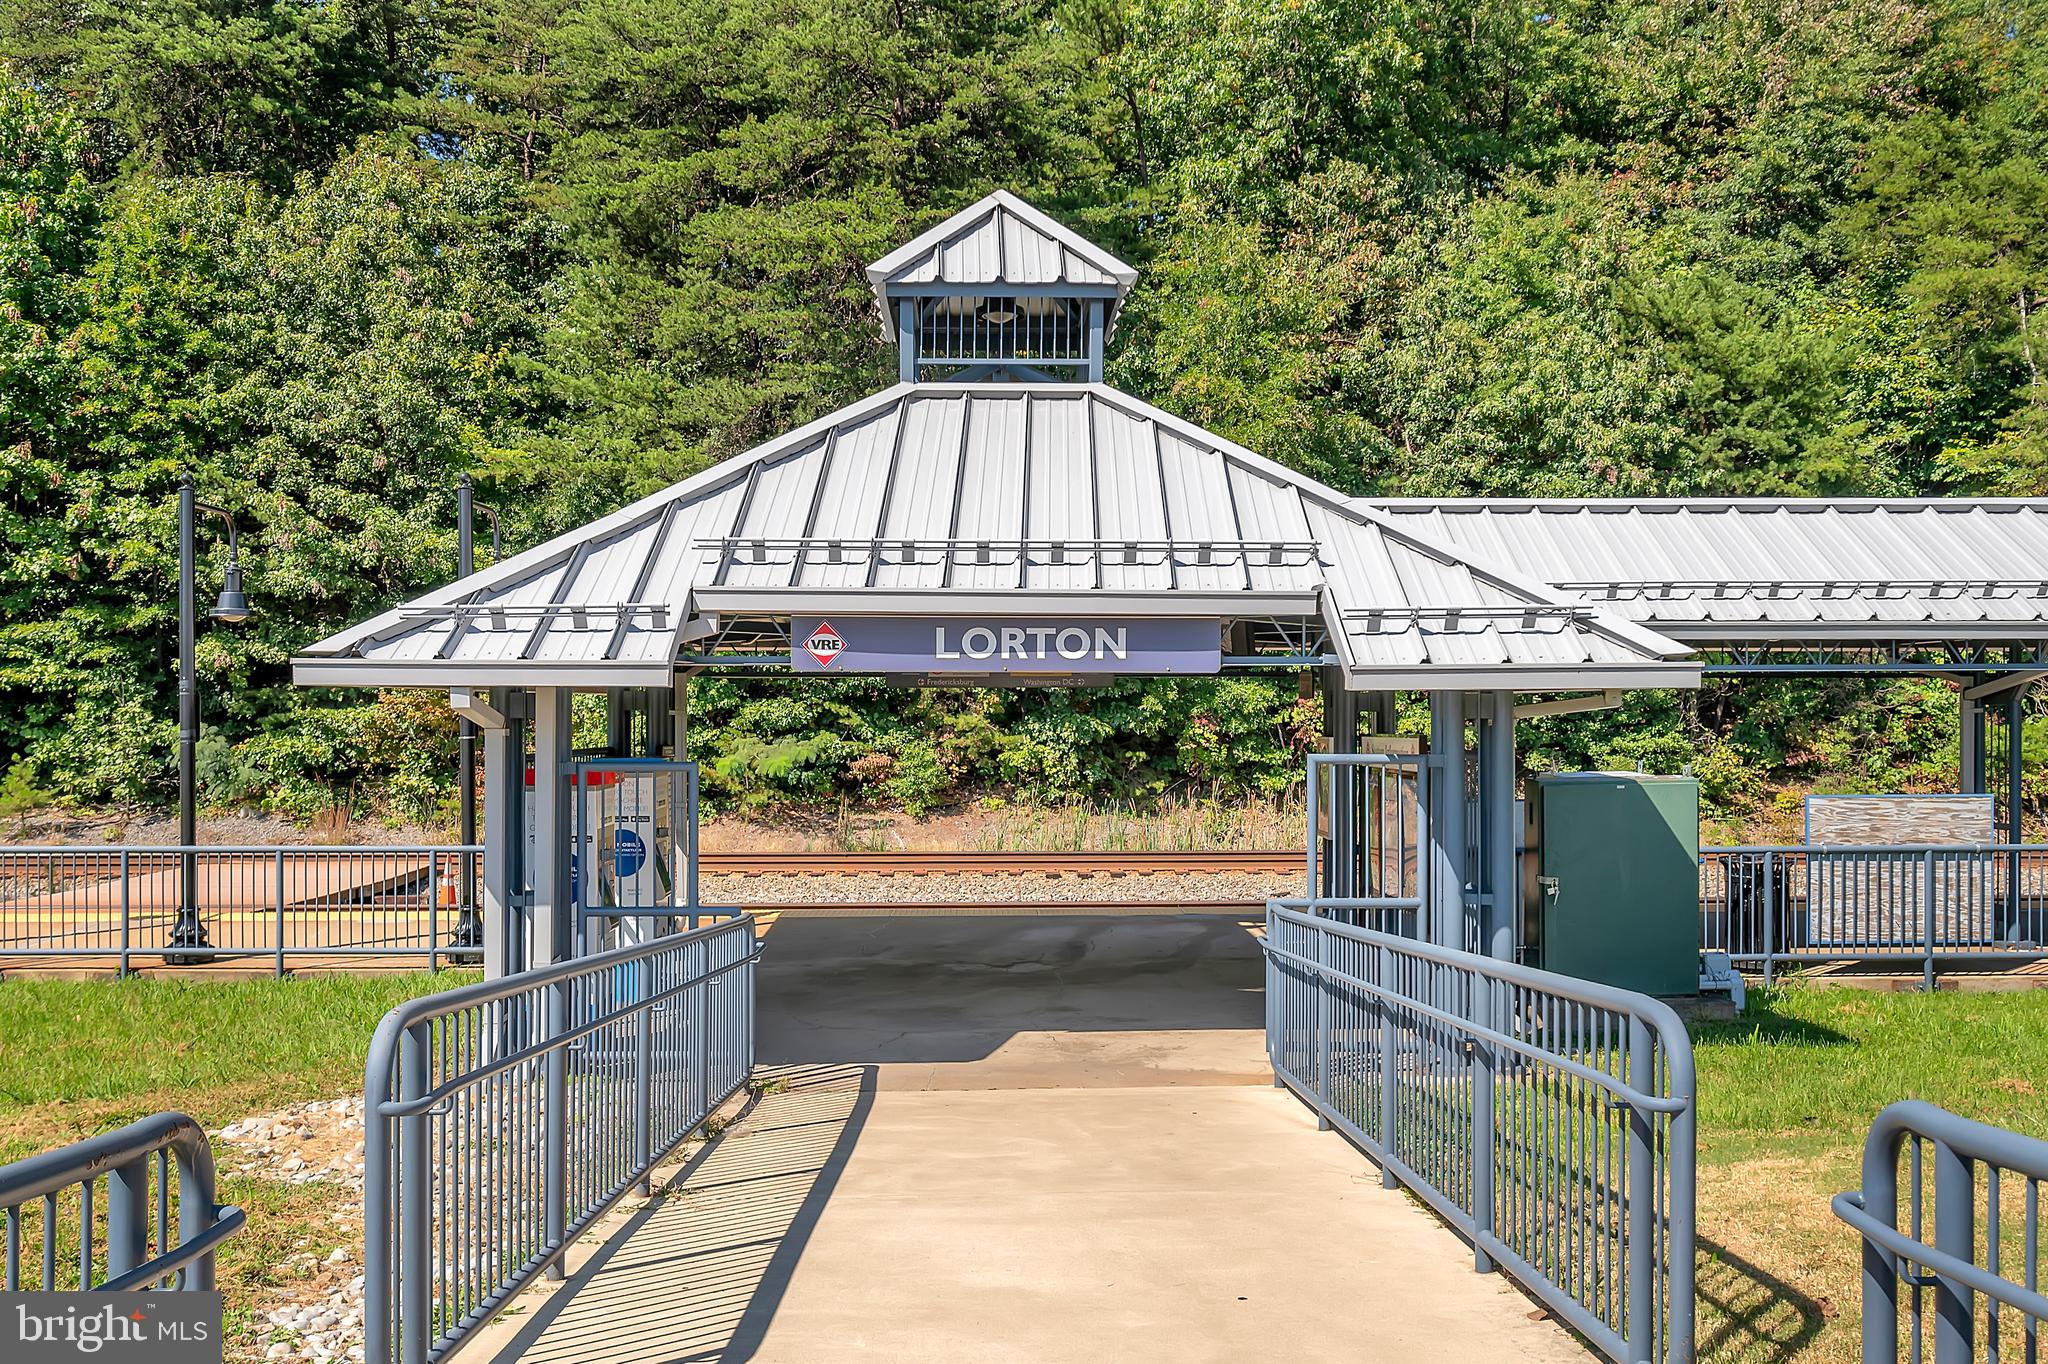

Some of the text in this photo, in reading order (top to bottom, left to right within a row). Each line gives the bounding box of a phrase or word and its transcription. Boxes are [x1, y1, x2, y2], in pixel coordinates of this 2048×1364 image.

[810, 639, 840, 650] VRE
[935, 627, 1127, 660] LORTON
[927, 678, 975, 687] Fredericksburg
[1023, 679, 1061, 687] Washington
